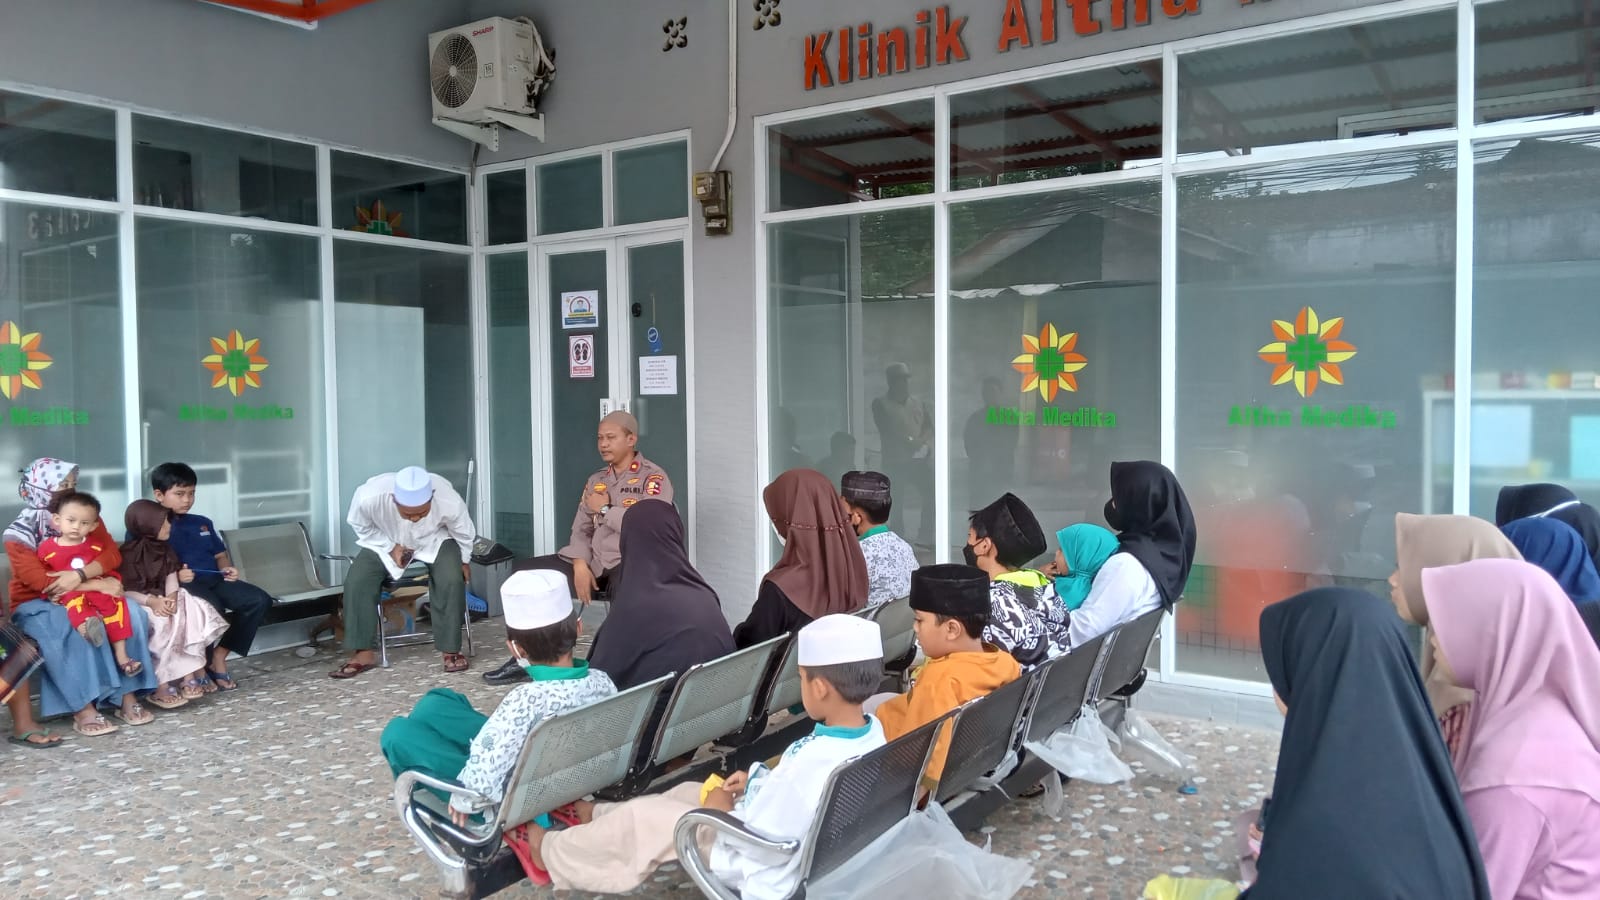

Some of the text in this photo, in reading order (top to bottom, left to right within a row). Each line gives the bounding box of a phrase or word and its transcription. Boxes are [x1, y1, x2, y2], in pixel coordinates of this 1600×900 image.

[472, 26, 494, 36] SHARP
[804, 5, 970, 91] Klinik
[10, 406, 90, 426] Medika
[179, 403, 294, 421] Altha Medika
[985, 406, 1117, 427] Altha Medika
[1228, 404, 1396, 429] Altha Medika
